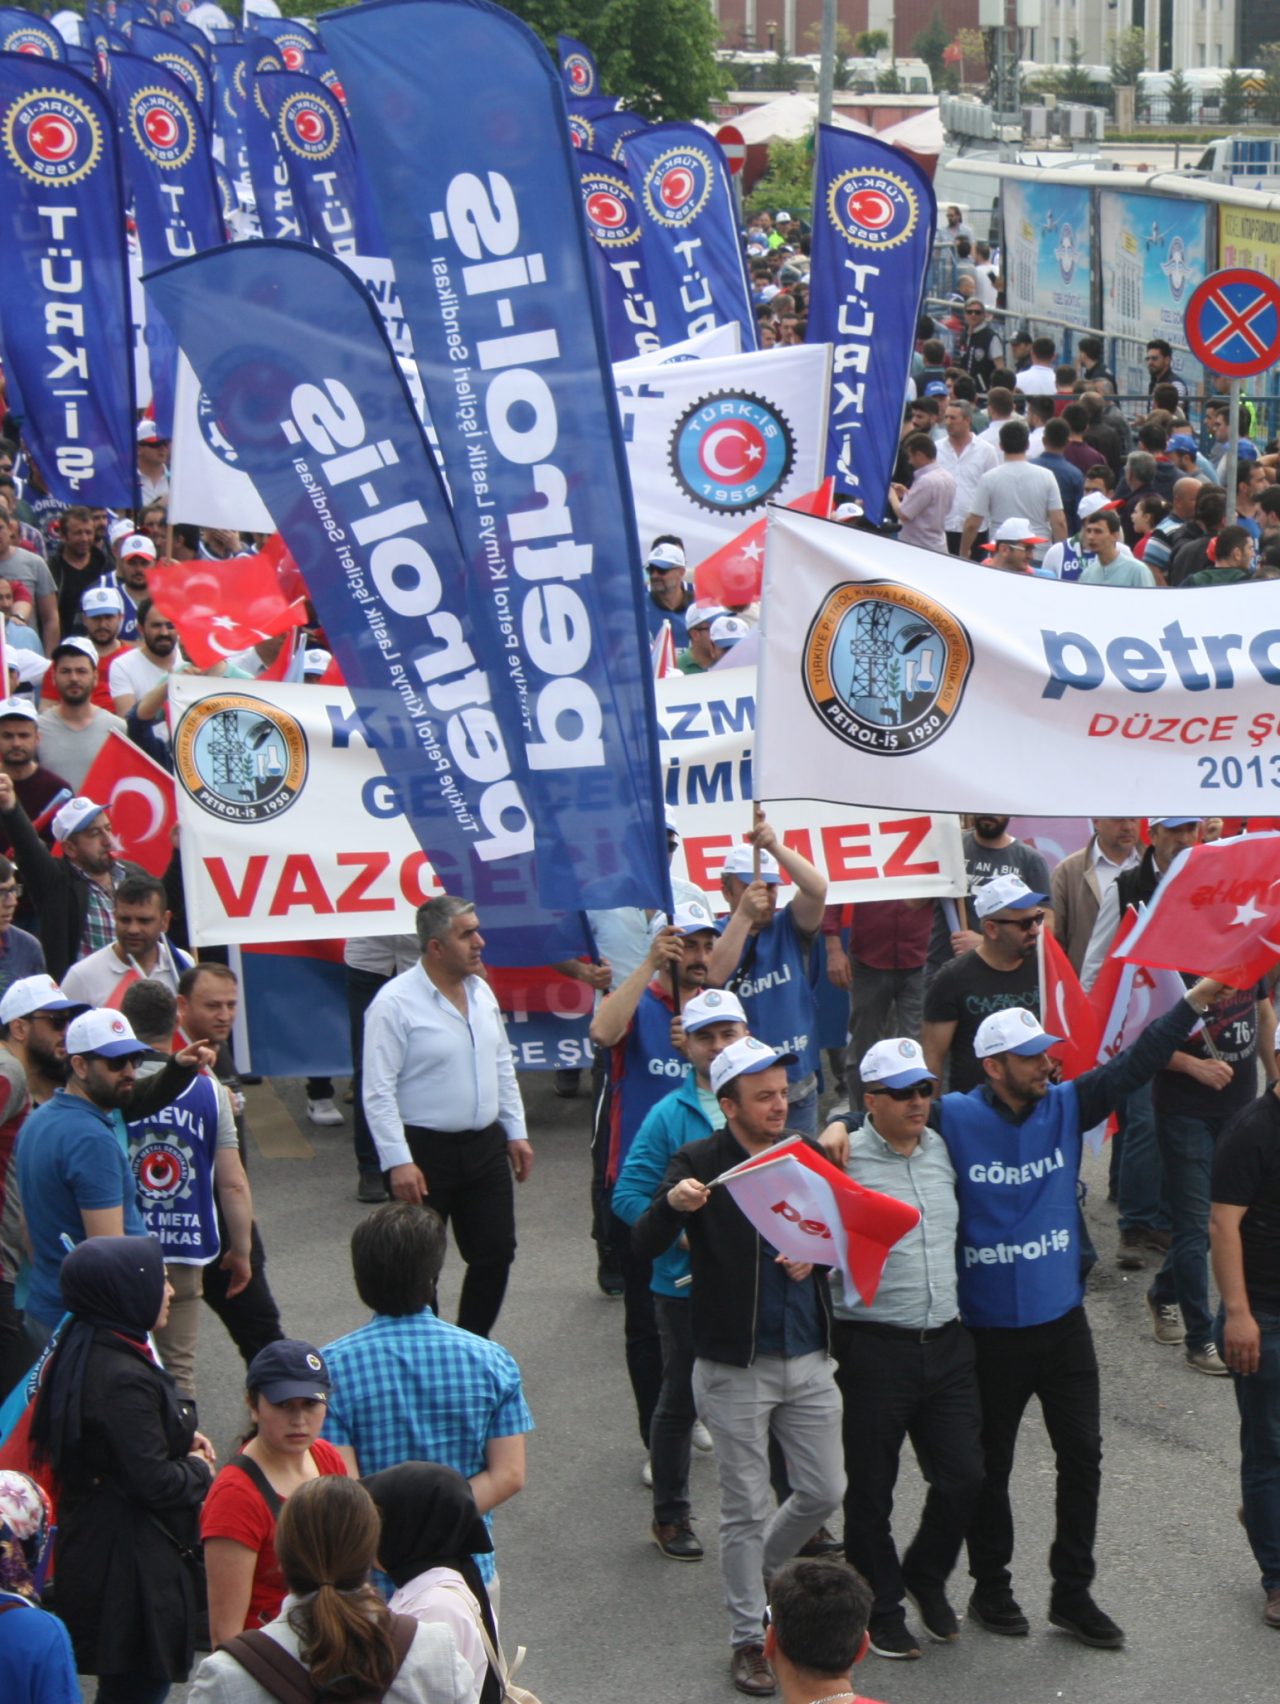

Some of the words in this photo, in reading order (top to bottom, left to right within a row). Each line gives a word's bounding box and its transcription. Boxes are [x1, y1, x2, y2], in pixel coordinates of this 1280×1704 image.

[688, 403, 778, 439] TÜRK-İŞ
[702, 483, 759, 502] 1952
[827, 704, 899, 749] PETROL-İŞ
[908, 715, 941, 744] 1950
[1087, 711, 1239, 745] DÜZCE
[263, 792, 290, 815] 1950
[1233, 1022, 1250, 1044] 76
[969, 1147, 1064, 1186] GÖREVLİ
[964, 1228, 1070, 1268] petrol-iş
